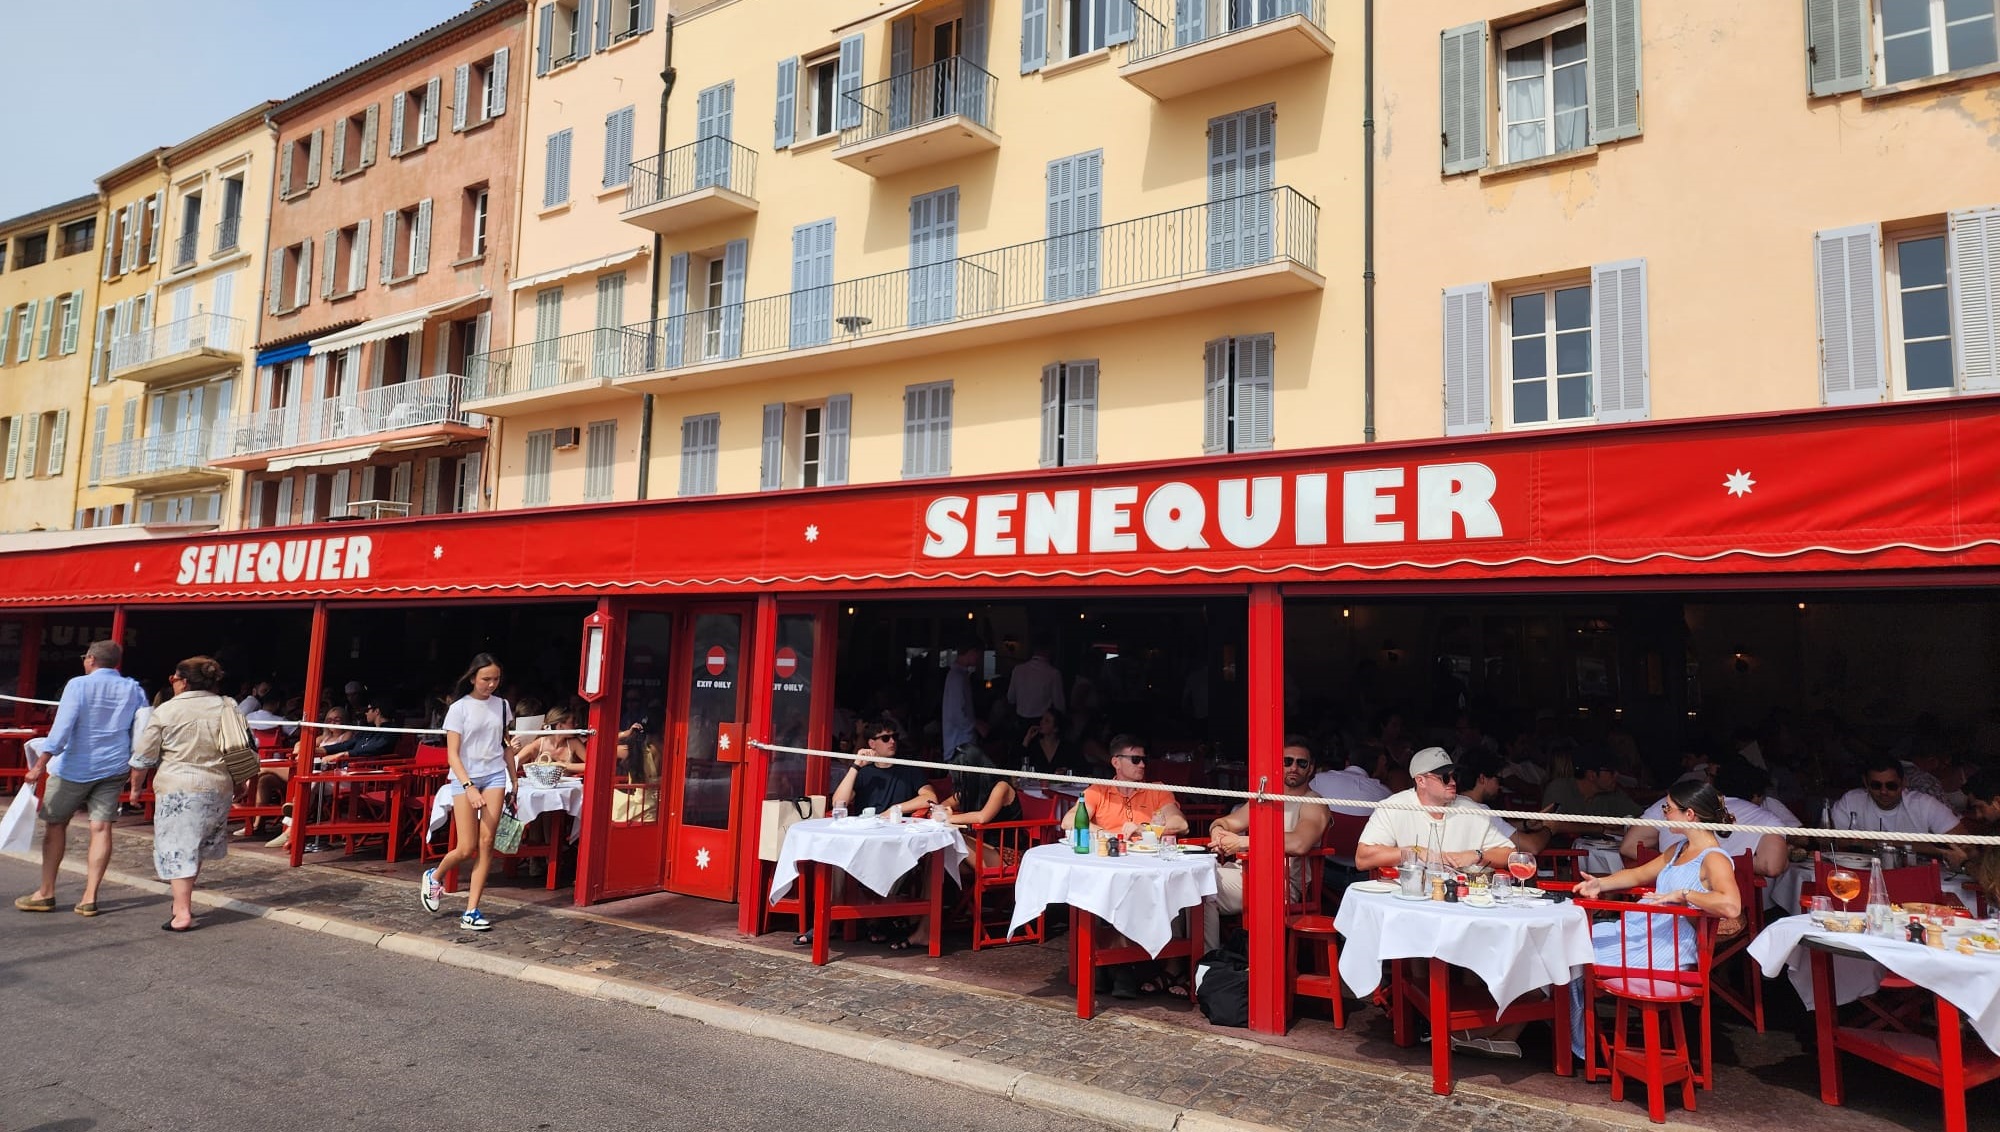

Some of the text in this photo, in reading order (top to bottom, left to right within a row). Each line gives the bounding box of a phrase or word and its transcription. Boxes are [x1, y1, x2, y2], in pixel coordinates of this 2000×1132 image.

[922, 461, 1504, 559] SENEQUIER
[176, 535, 373, 585] SENEQUIER
[696, 680, 732, 689] EXIT ONLY
[783, 683, 804, 692] ONLY
